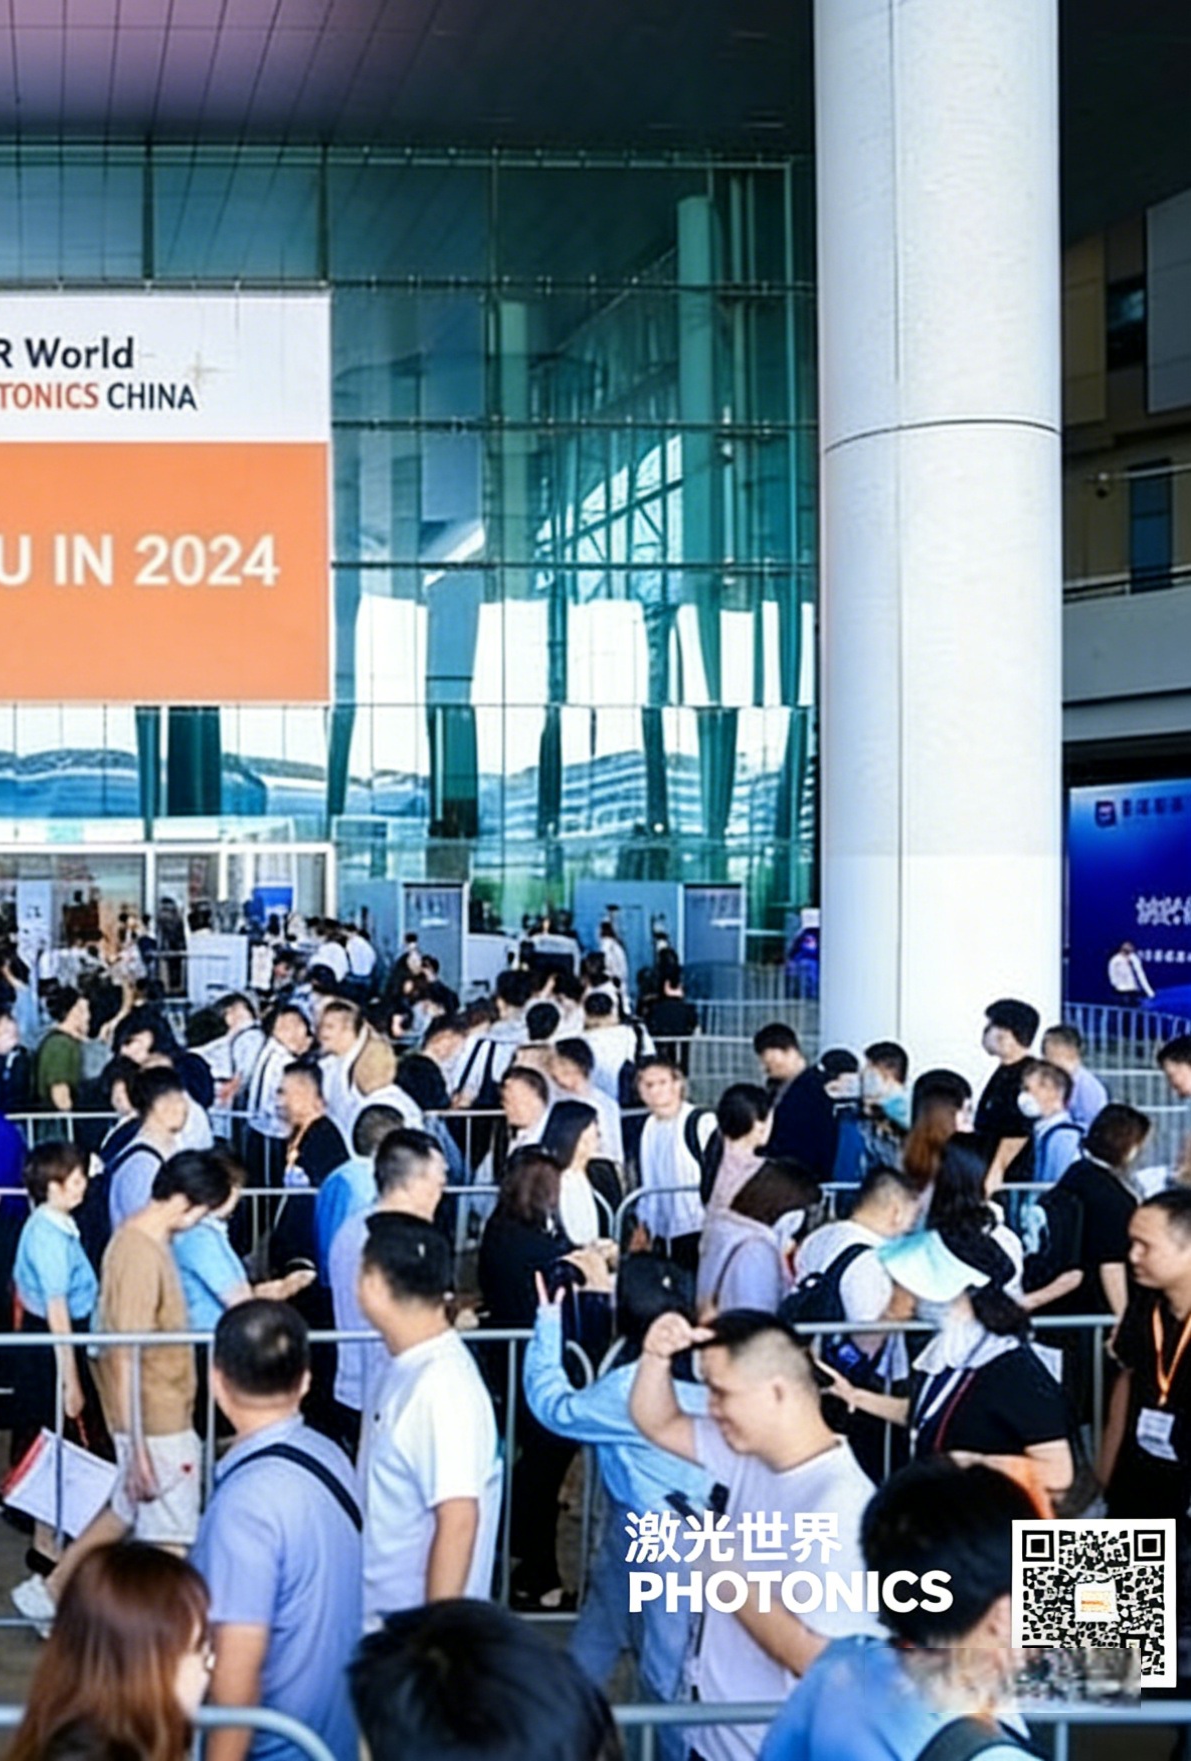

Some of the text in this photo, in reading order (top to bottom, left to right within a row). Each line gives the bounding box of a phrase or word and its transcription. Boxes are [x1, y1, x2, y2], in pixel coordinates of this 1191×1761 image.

[24, 335, 134, 370] World
[106, 382, 197, 410] CHINA
[55, 535, 113, 587] IN
[135, 534, 279, 587] 2024
